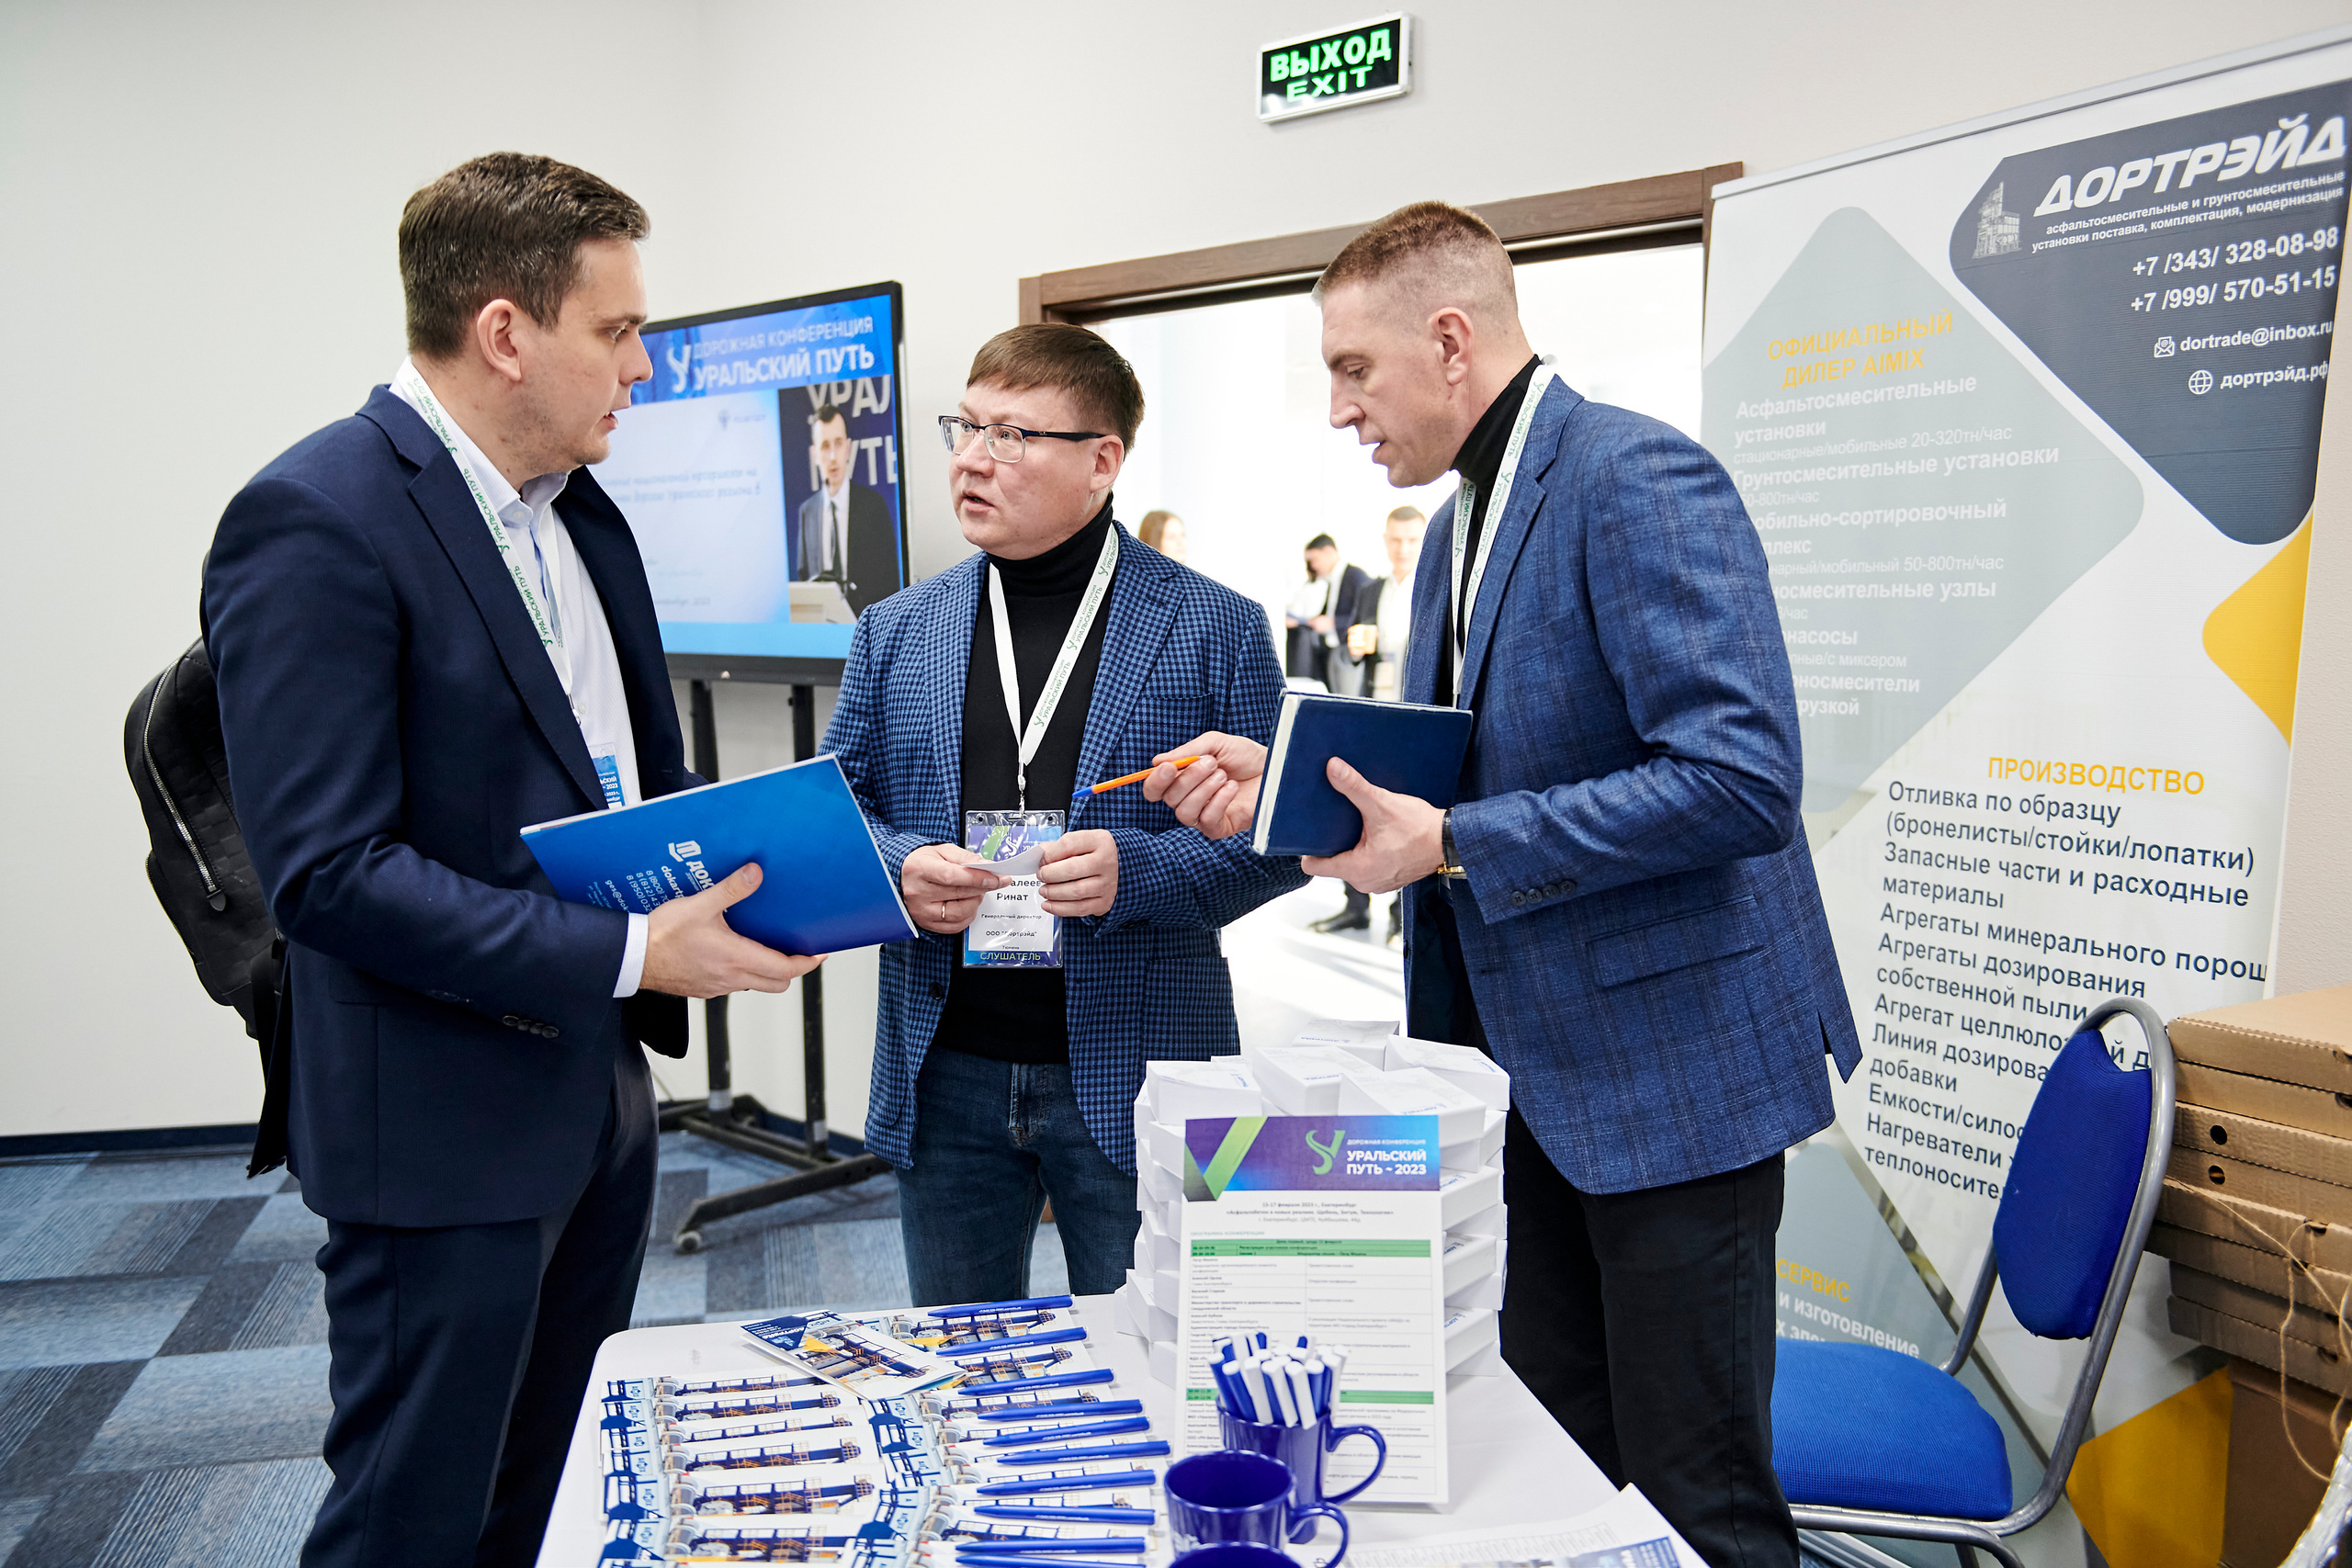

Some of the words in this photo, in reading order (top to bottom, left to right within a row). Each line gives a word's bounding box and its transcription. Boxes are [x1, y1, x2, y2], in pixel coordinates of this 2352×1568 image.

[1270, 28, 1392, 83] ВЫХОД
[1286, 65, 1373, 103] EXIT
[2032, 112, 2347, 218] ДОРТРЭЙД
[2031, 231, 2089, 254] установки
[2091, 222, 2148, 242] поставка,
[2150, 205, 2244, 231] комплектация,
[2245, 186, 2344, 215] модернизация
[2045, 200, 2188, 235] асфальтосмесительные
[2191, 198, 2200, 209] и
[2203, 170, 2346, 209] грунтосмесительные
[2132, 256, 2159, 276] +7
[2164, 245, 2221, 275] /343/
[2225, 226, 2339, 265] 328-08-98
[2131, 292, 2157, 312] +7
[2162, 283, 2219, 310] /999/
[2223, 265, 2337, 302] 570-51-15
[769, 316, 874, 346] КОНФЕРЕНЦИЯ
[1768, 308, 1953, 360] ОФИЦИАЛЬНЫЙ
[2180, 321, 2333, 352] dortrade@inbox.ru
[695, 347, 809, 391] УРАЛЬСКИЙ
[816, 344, 875, 375] ПУТЬ
[1782, 357, 1856, 390] ДИЛЕР
[1861, 347, 1926, 377] AIMIX
[2220, 360, 2330, 389] дортрэйд.рф
[1735, 376, 1977, 420] Асфальтосмесительные
[1734, 421, 1826, 448] установки
[1911, 425, 2013, 449] 20-320тн/час
[1733, 456, 1938, 491] Грунтосмесительные
[1942, 446, 2060, 477] установки
[1754, 497, 2007, 530] обильно-сортировочный
[1763, 537, 1812, 555] плекс
[1904, 555, 2005, 572] 50-800тн/час
[1939, 581, 1996, 603] узлы
[1075, 602, 1096, 644] УРАЛЬСКИЙ
[1839, 652, 1907, 668] миксером
[1043, 678, 1063, 719] УРАЛЬСКИЙ
[1987, 756, 2205, 795] ПРОИЗВОДСТВО
[1888, 781, 1978, 810] Отливка
[1985, 794, 2012, 813] по
[2019, 794, 2121, 829] образцу
[1886, 811, 2256, 877] (бронелисты/стойки/лопатки)
[1883, 874, 2004, 909] материалы
[1884, 840, 1990, 874] Запасные
[1998, 858, 2061, 885] части
[2068, 868, 2084, 886] и
[2093, 871, 2249, 908] расходные
[996, 893, 1029, 902] Ринат
[1881, 902, 1979, 938] Агрегаты
[1987, 923, 2166, 967] минерального
[980, 952, 1041, 962] СЛУШАТЕЛЬ
[1878, 932, 1977, 969] Агрегаты
[1984, 953, 2145, 998] дозирования
[1874, 993, 1954, 1028] Агрегат
[1877, 966, 2015, 1009] собственной
[2022, 994, 2087, 1021] пыли
[1872, 1022, 1937, 1055] Линия
[1942, 1039, 2048, 1082] дозирова
[1870, 1057, 1957, 1092] добавки
[1347, 1148, 1427, 1162] УРАЛЬСКИЙ
[1867, 1111, 2001, 1168] Нагреватели
[1347, 1164, 1383, 1175] ПУТЬ
[1395, 1164, 1427, 1175] 2023
[1865, 1145, 2001, 1200] теплоносите
[1776, 1258, 1850, 1303] СЕРВИС
[1794, 1298, 1919, 1359] изготовление
